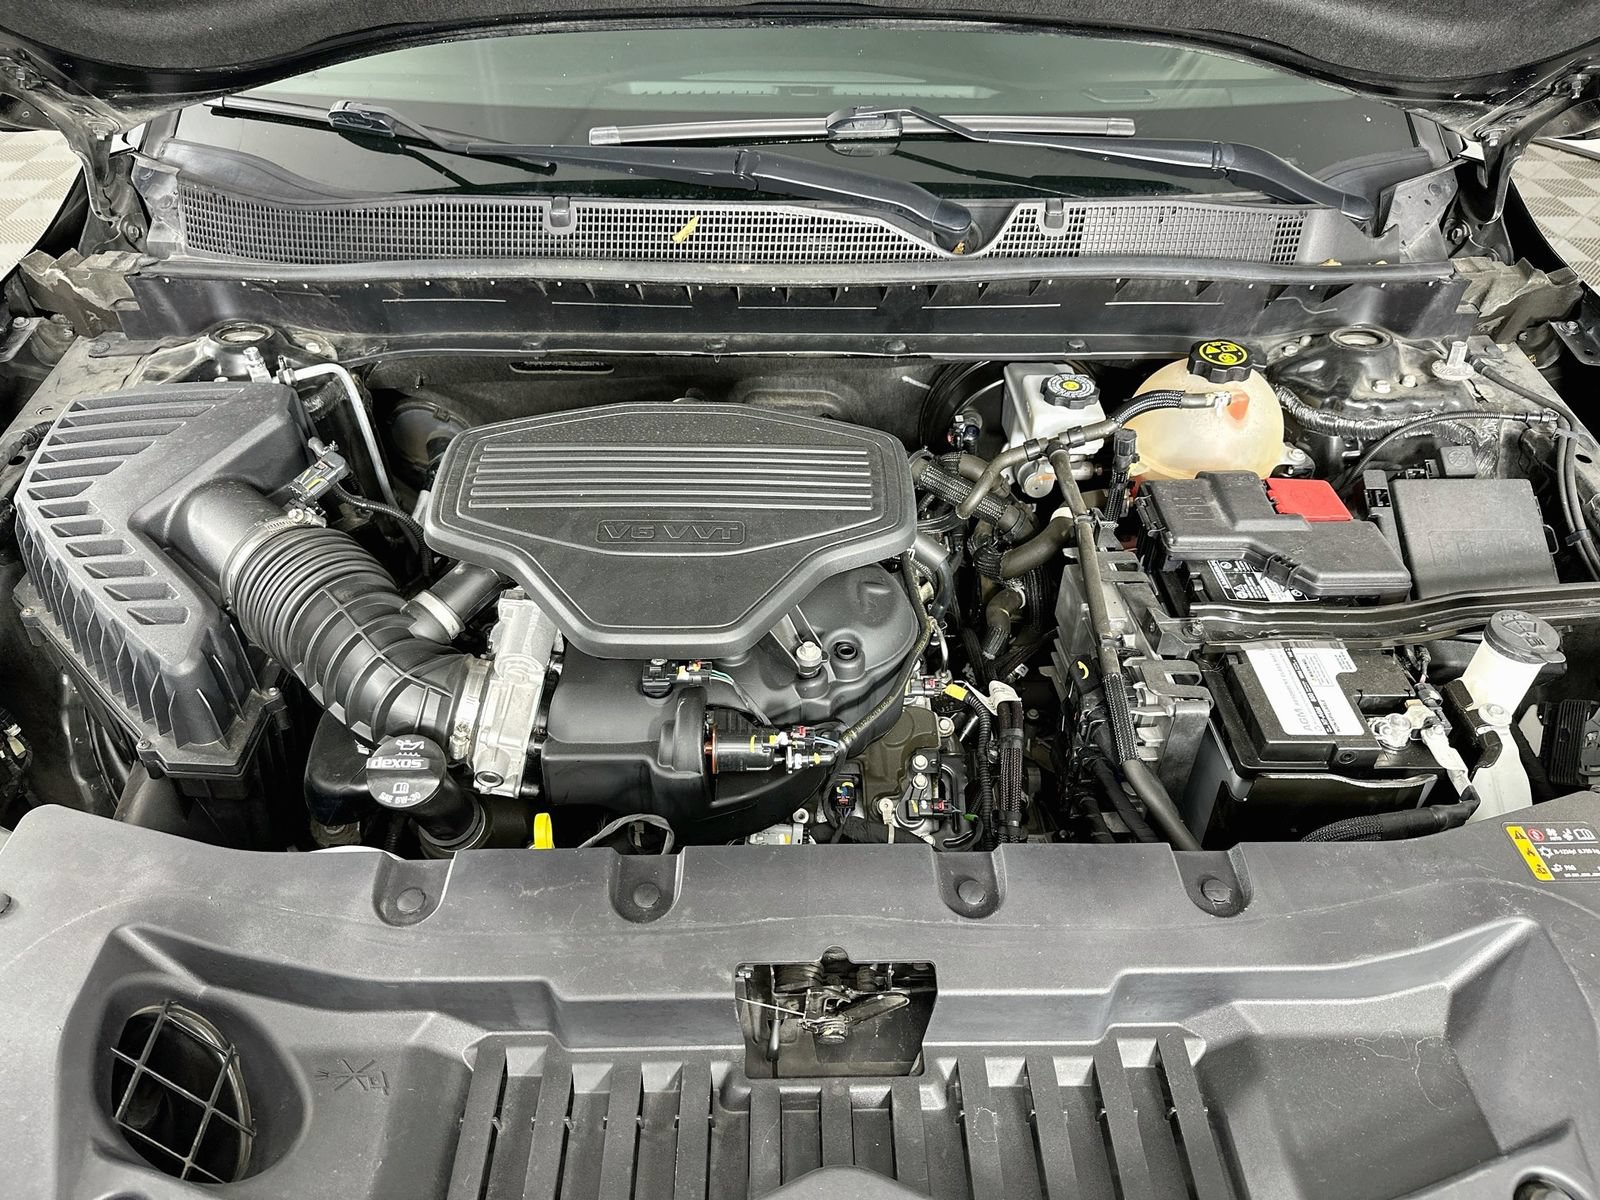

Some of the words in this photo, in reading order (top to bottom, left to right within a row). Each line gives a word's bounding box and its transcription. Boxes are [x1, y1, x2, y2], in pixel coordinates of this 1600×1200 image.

[604, 524, 655, 539] V6
[663, 525, 739, 540] VVT
[370, 756, 424, 768] dexos
[379, 792, 394, 803] SAE
[395, 792, 421, 804] 5W-30
